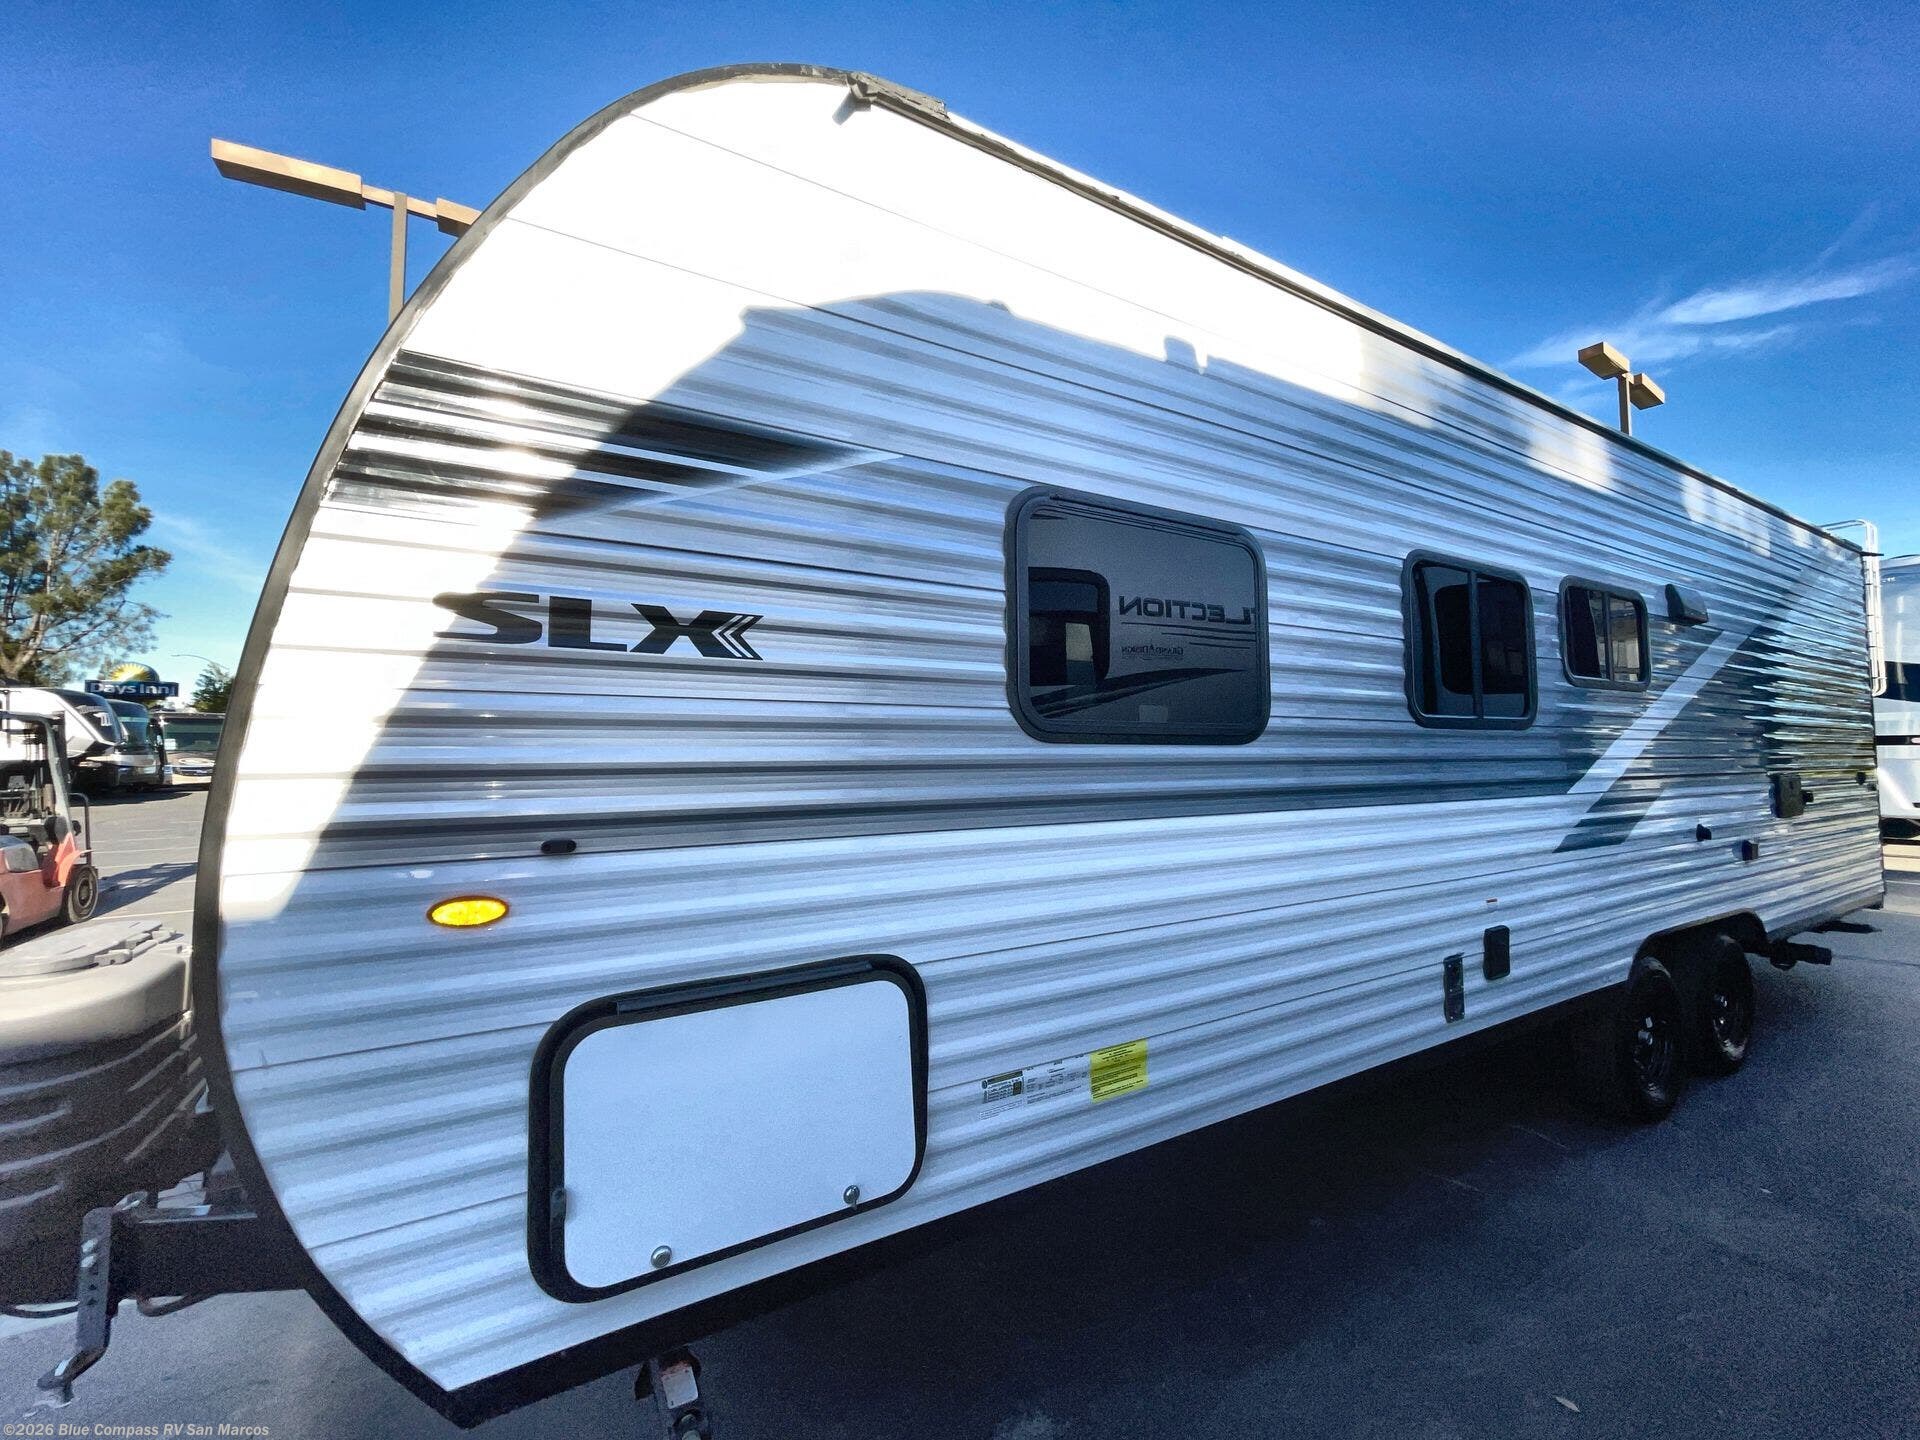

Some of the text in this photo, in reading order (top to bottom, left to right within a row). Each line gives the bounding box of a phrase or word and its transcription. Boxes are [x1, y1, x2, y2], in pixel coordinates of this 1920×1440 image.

[432, 591, 764, 661] SLX
[90, 682, 170, 694] Days Inn
